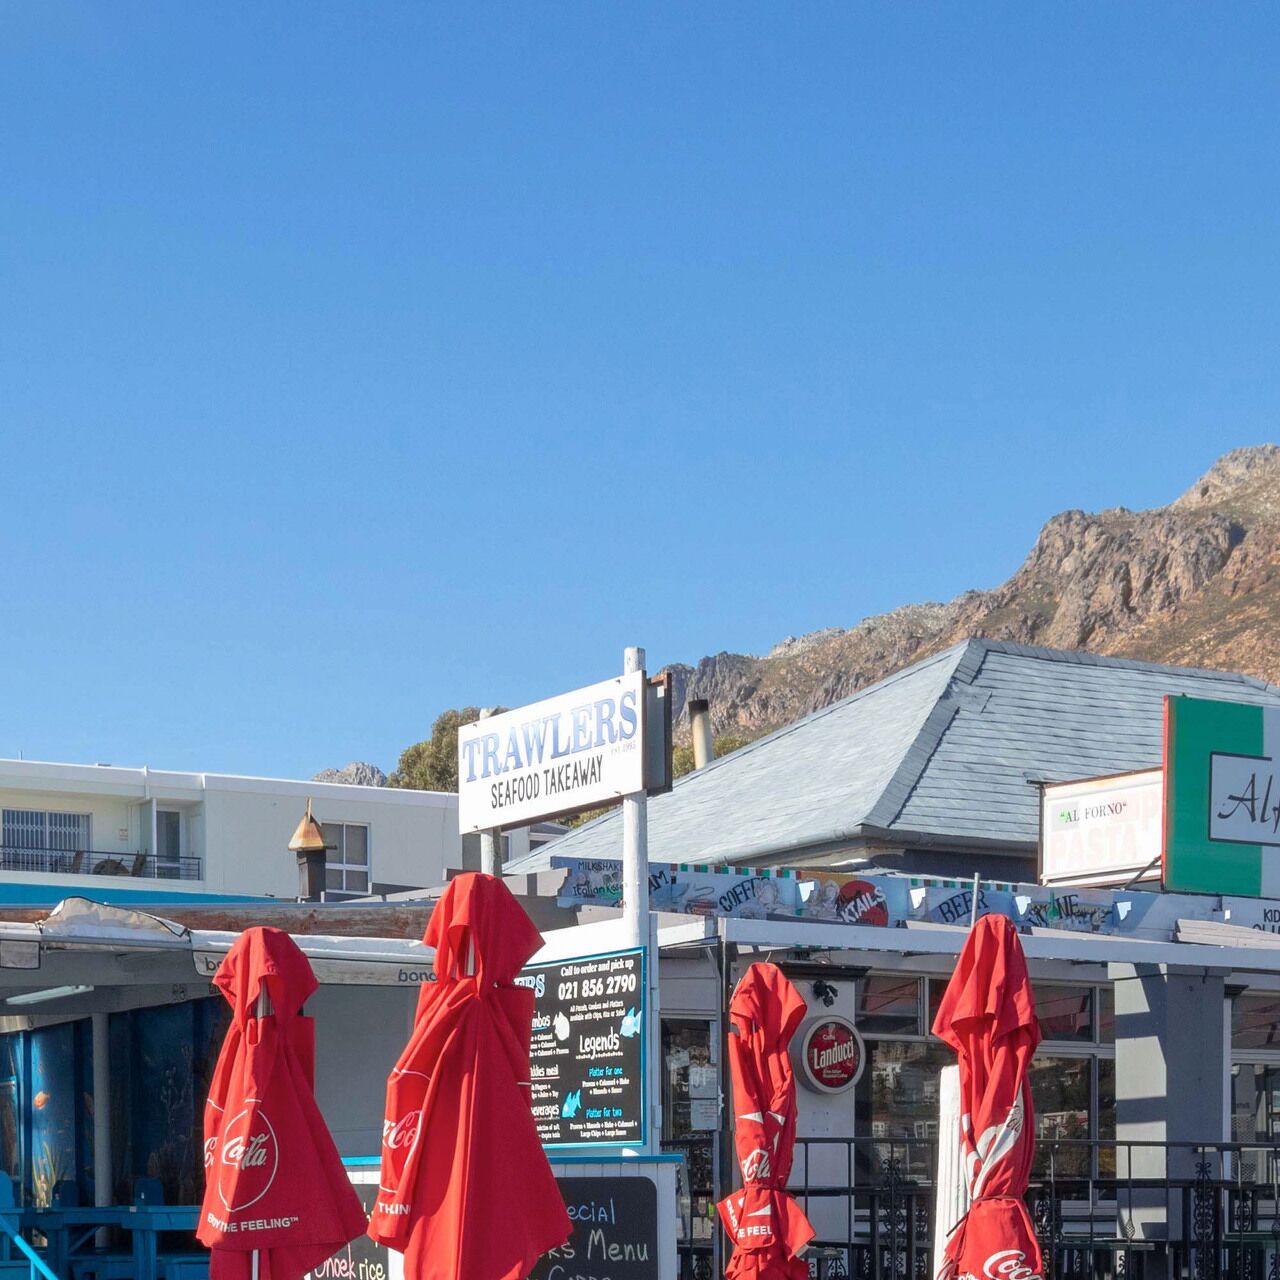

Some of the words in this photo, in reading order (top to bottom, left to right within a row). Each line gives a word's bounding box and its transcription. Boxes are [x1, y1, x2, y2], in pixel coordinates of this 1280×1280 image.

[463, 689, 638, 783] TRAWLERS
[491, 772, 540, 809] SEAFOOD
[544, 754, 604, 796] TAKEAWAY
[560, 965, 573, 977] Call
[581, 963, 598, 974] order
[598, 960, 610, 972] and
[610, 959, 624, 973] pick
[558, 981, 578, 1000] 021
[581, 978, 604, 998] 856
[606, 974, 636, 995] 2790
[579, 1026, 620, 1059] Legends
[813, 1036, 854, 1070] Landucci
[587, 1228, 649, 1263] Menu
[358, 1258, 386, 1280] rice
